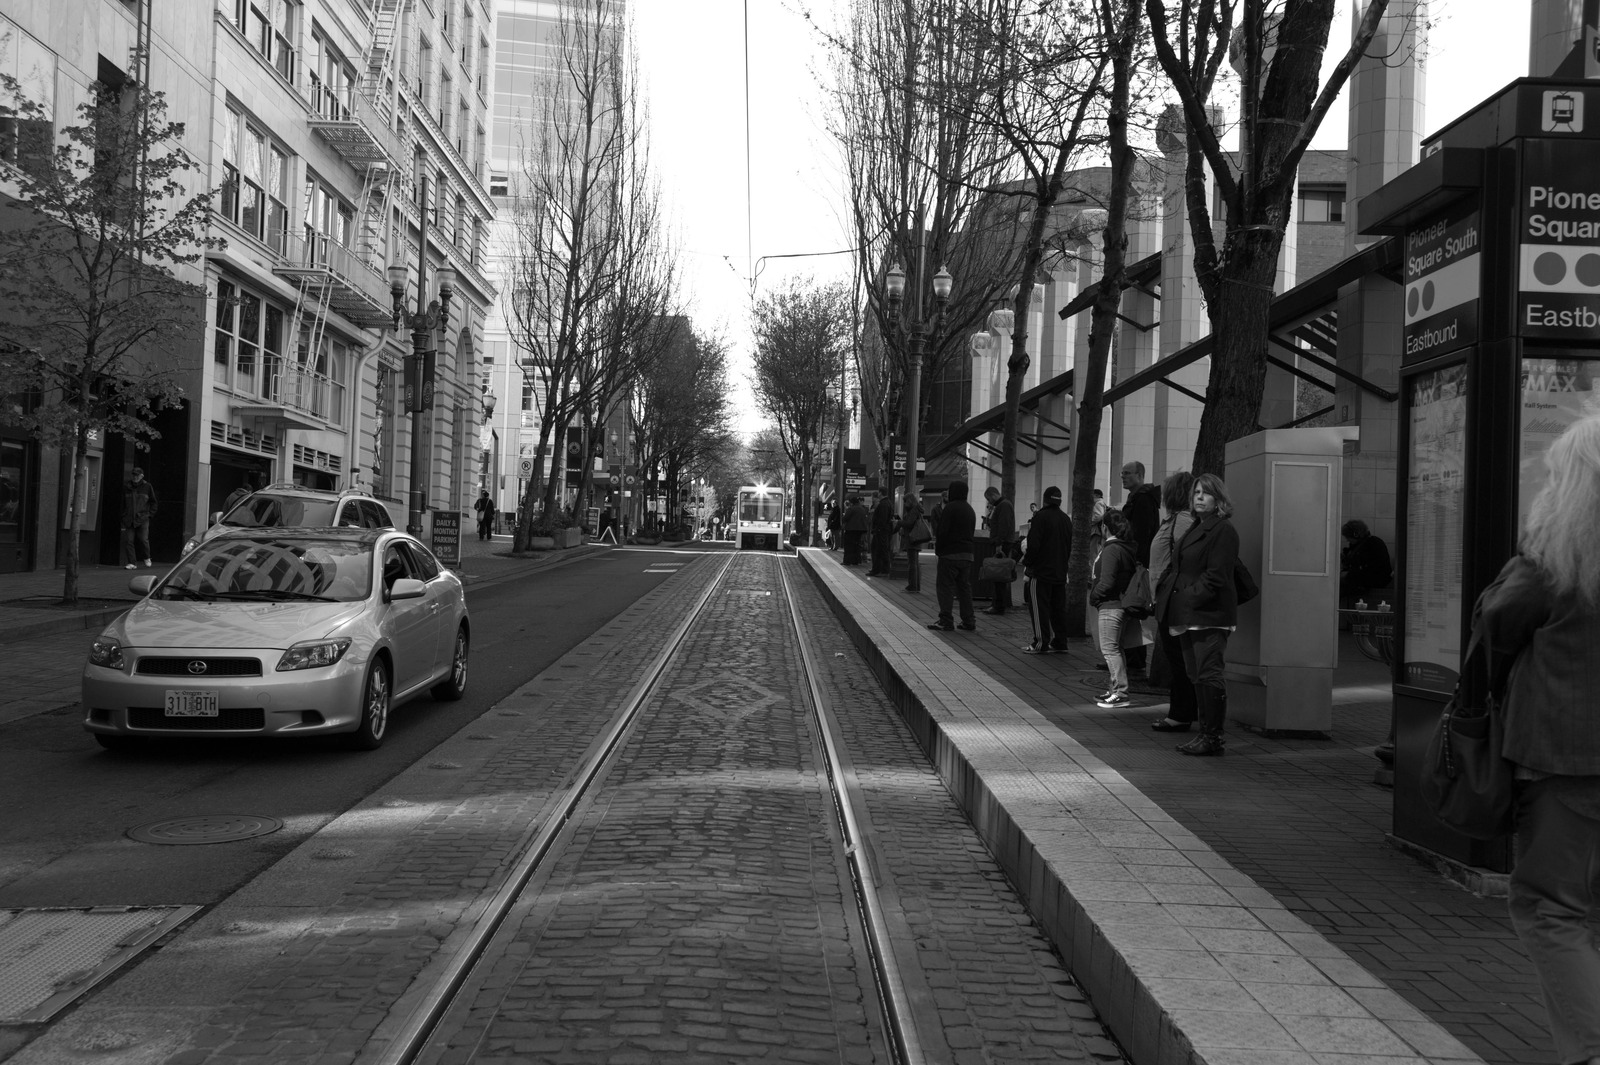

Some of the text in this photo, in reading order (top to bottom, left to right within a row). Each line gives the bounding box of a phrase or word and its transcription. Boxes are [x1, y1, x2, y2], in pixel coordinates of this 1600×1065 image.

[1530, 186, 1600, 210] Pione
[1409, 219, 1448, 251] Pioneer
[1529, 214, 1600, 242] Squar
[1408, 227, 1478, 276] Square South
[1526, 304, 1600, 328] Eastb
[1406, 318, 1458, 355] Eastbound
[1526, 374, 1577, 392] MAX
[1536, 402, 1557, 410] System
[433, 527, 458, 535] MONTHLY
[436, 519, 457, 527] DAILY &
[433, 536, 457, 544] PARKING
[167, 696, 216, 711] 311 BTH
